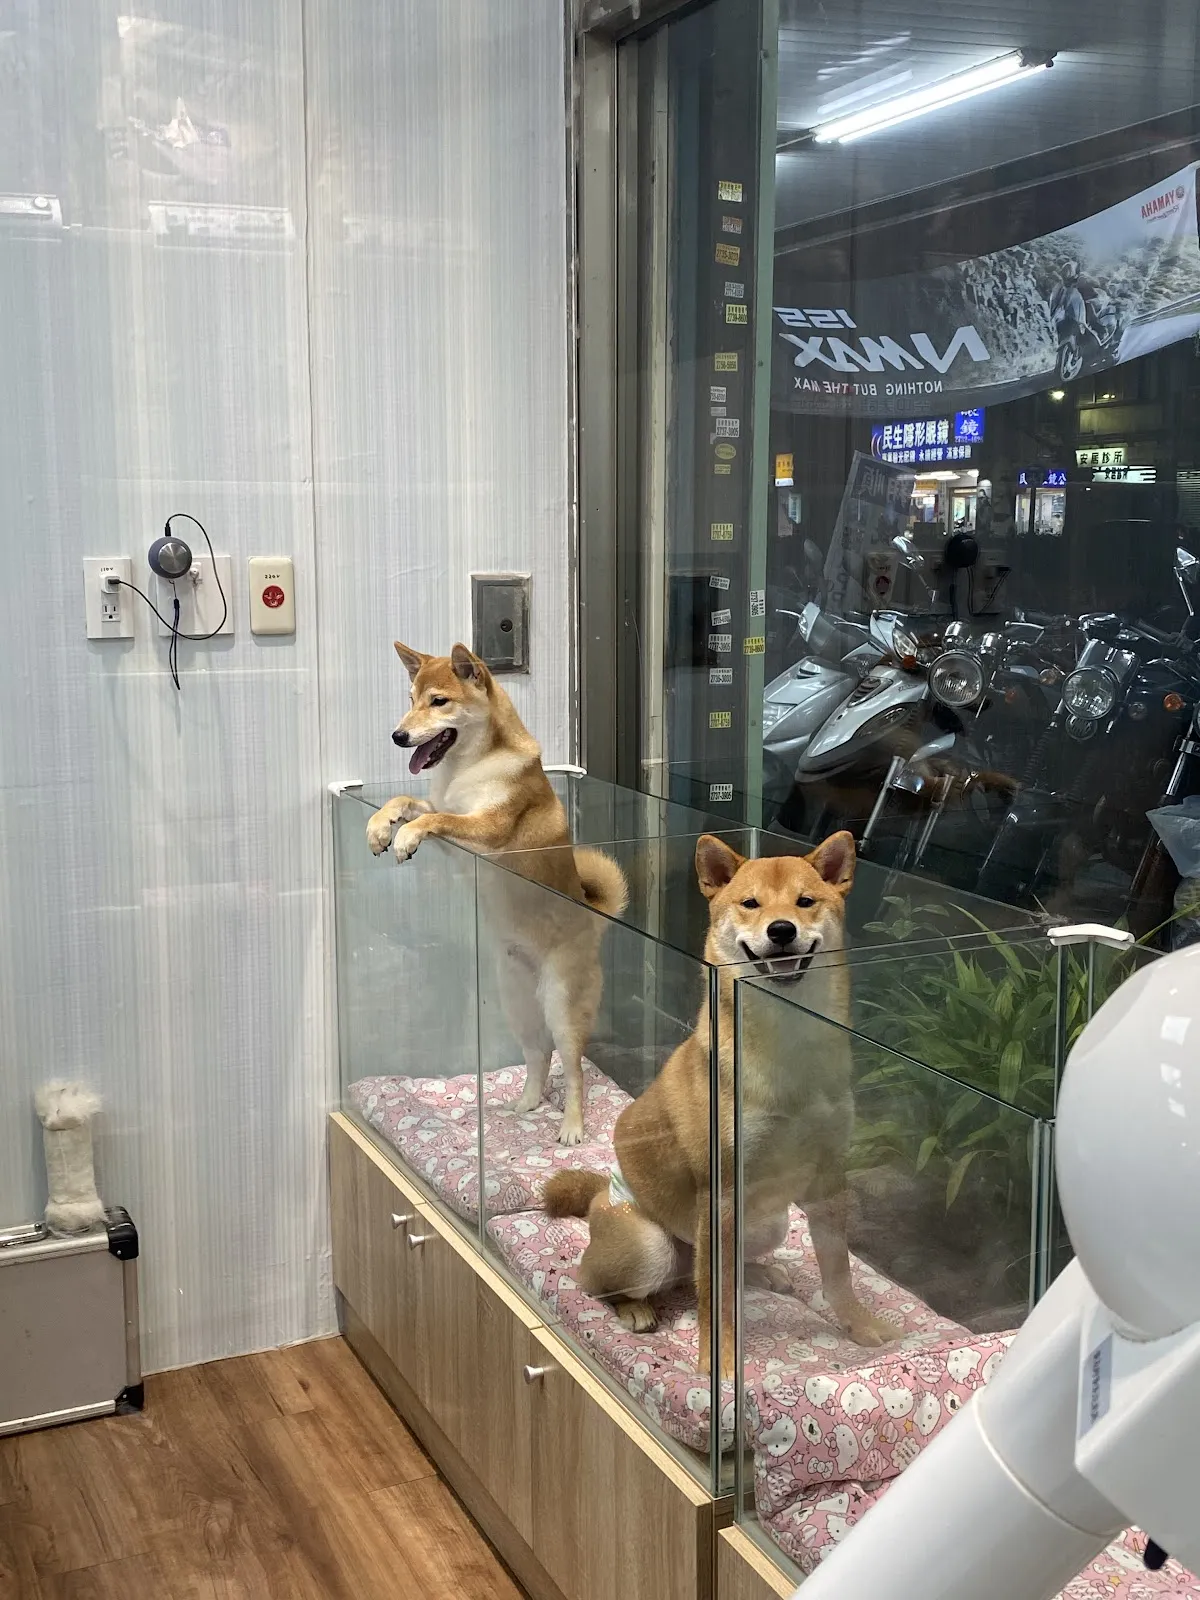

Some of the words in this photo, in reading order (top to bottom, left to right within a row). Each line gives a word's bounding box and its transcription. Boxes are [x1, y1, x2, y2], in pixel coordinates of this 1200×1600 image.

[882, 419, 949, 450] 民生隱形眼鏡
[1079, 450, 1123, 466] 安居診所
